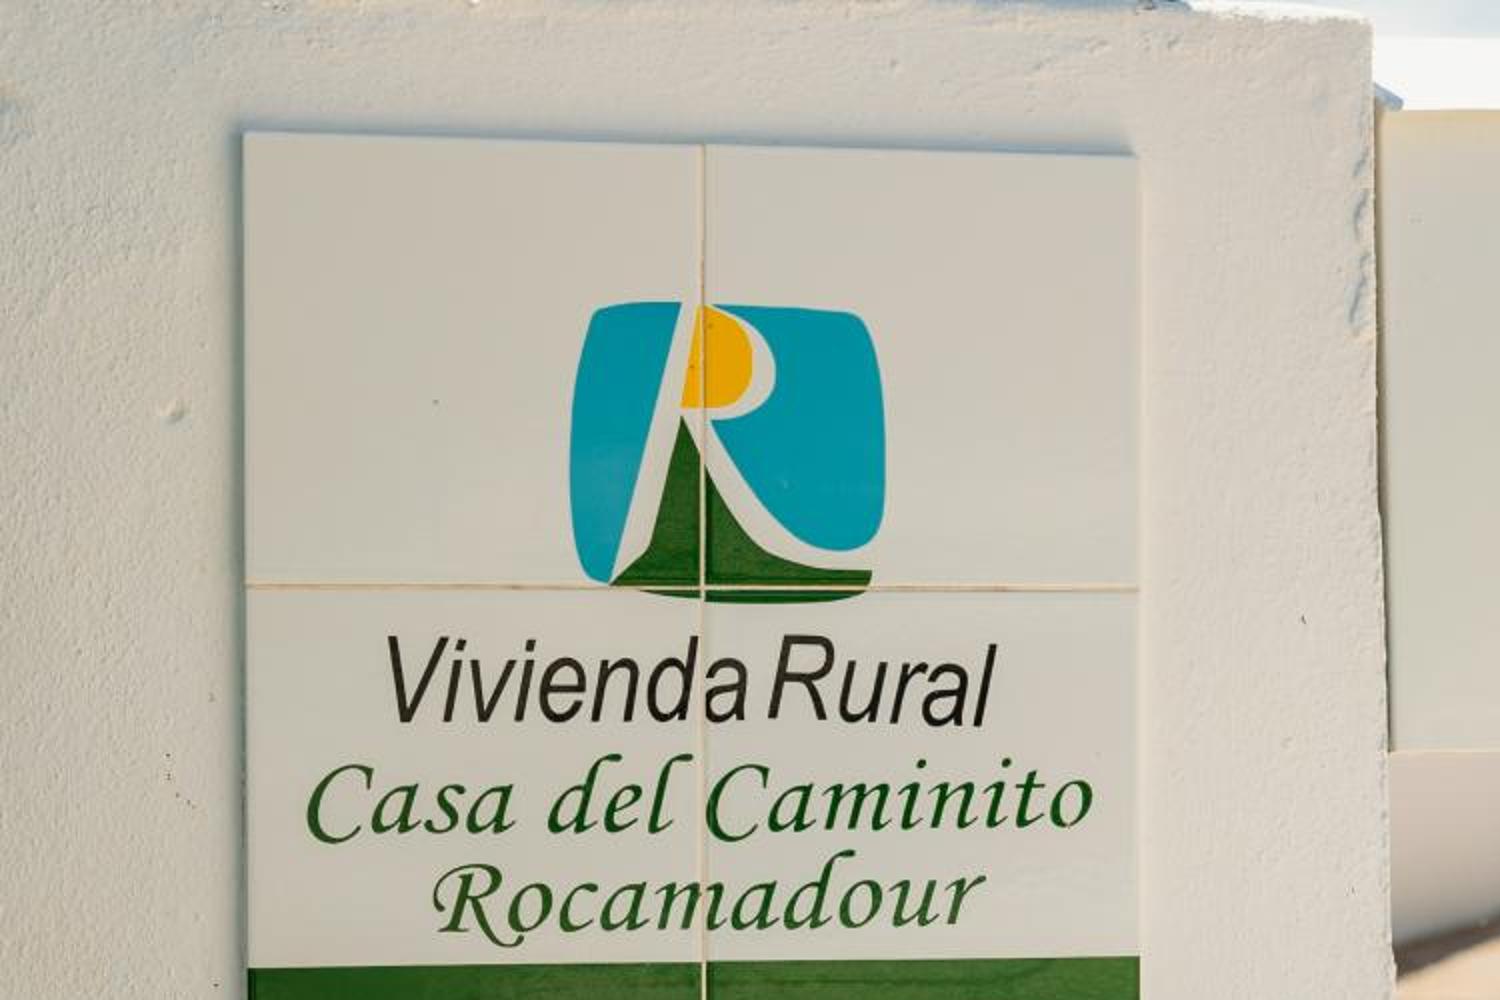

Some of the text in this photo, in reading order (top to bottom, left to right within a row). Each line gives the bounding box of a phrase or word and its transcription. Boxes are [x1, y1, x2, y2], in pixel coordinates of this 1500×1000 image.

[387, 633, 999, 727] Vivienda Rural
[305, 753, 1094, 844] Casa del Caminito
[432, 849, 988, 947] Rocamadour
